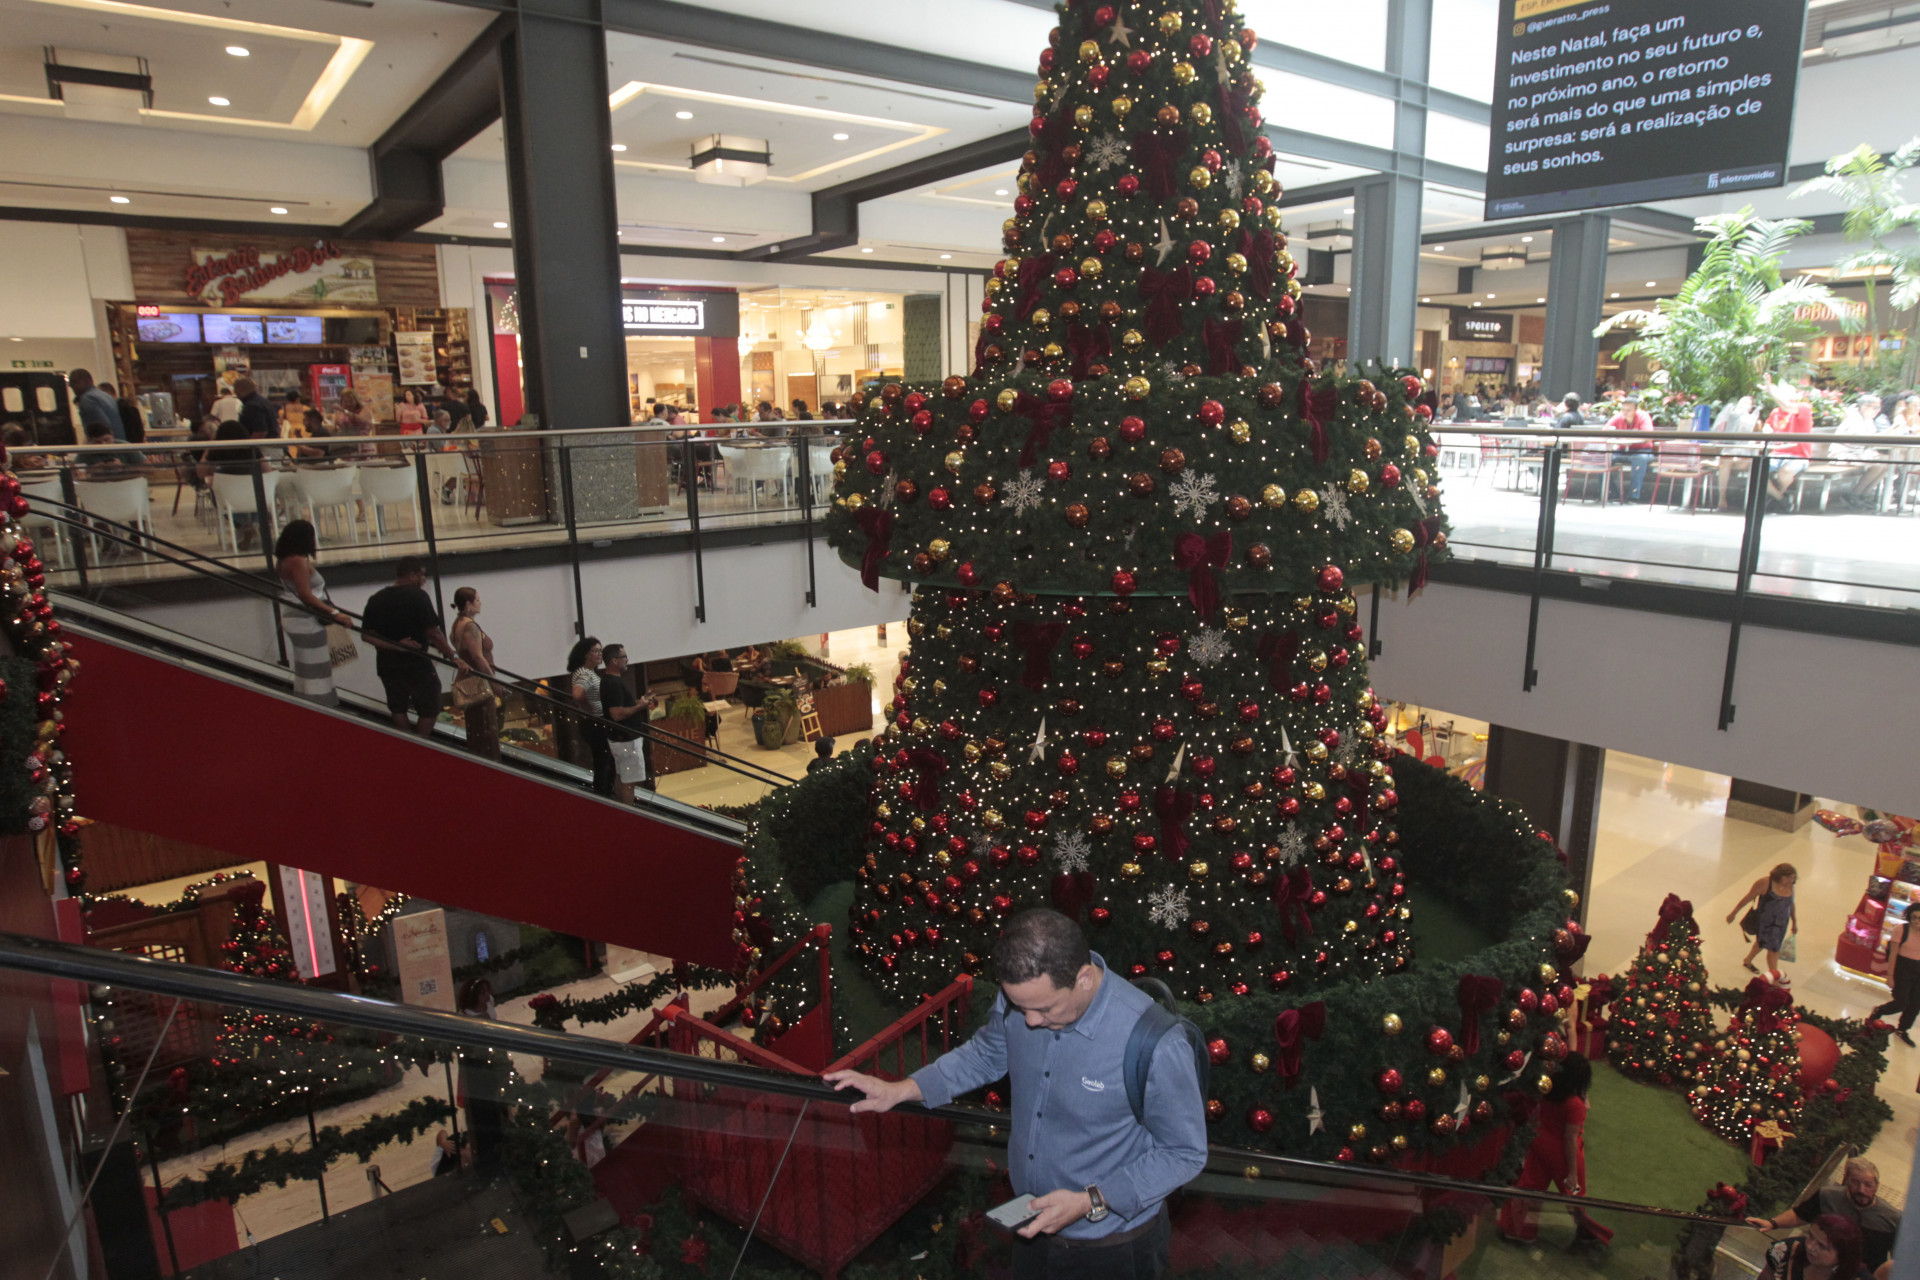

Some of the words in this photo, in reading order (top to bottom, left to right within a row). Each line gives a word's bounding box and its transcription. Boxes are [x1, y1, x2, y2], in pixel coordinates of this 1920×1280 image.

[1510, 56, 1614, 88] investimento
[1618, 50, 1641, 66] no
[1645, 42, 1678, 60] seu
[1682, 28, 1742, 52] futuro
[1746, 24, 1763, 39] e,
[1511, 45, 1557, 66] Neste
[1560, 31, 1608, 55] Natal,
[1612, 23, 1651, 43] faça
[1655, 15, 1685, 33] um
[1506, 112, 1540, 132] será
[1543, 106, 1582, 125] mais
[1586, 102, 1608, 118] do
[1612, 96, 1646, 115] que
[1651, 88, 1691, 106] uma
[1696, 73, 1772, 98] simples
[1508, 96, 1528, 110] no
[1531, 82, 1597, 108] próximo
[1601, 75, 1638, 92] ano,
[1642, 71, 1654, 84] o
[1659, 56, 1729, 81] retorno
[1504, 131, 1577, 154] surpresa:
[1580, 121, 1616, 142] será
[1620, 122, 1632, 135] a
[1636, 104, 1731, 132] realização
[1736, 98, 1762, 116] de
[1503, 159, 1539, 175] seus
[1542, 150, 1604, 170] sonhos.
[1465, 320, 1501, 332] SPOLETO
